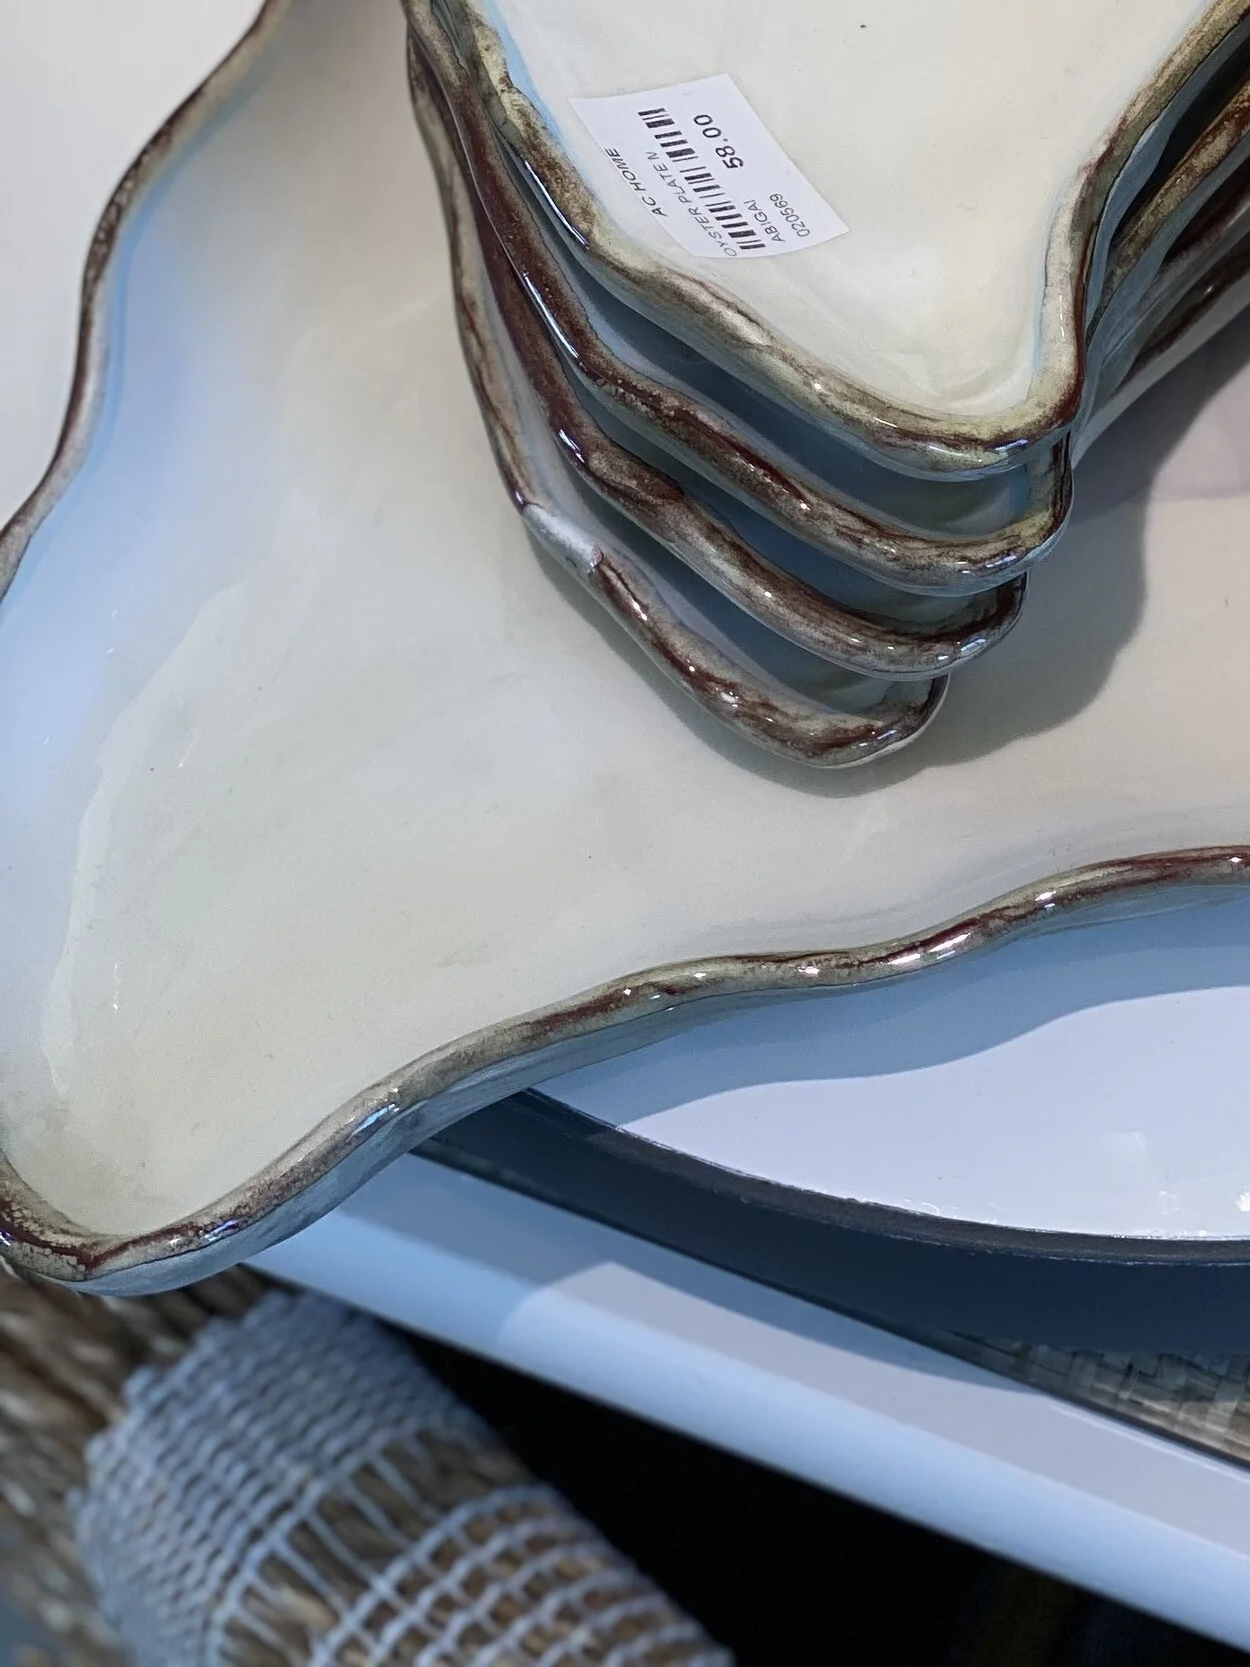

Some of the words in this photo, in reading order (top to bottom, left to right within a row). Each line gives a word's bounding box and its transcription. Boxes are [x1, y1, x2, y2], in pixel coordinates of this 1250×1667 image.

[693, 113, 745, 170] 58.00
[605, 147, 647, 193] HOME
[654, 164, 689, 204] PLATE
[642, 197, 667, 218] AC
[743, 199, 785, 243] ABIGAI
[768, 193, 810, 237] 020569
[688, 207, 738, 257] OYSTER
